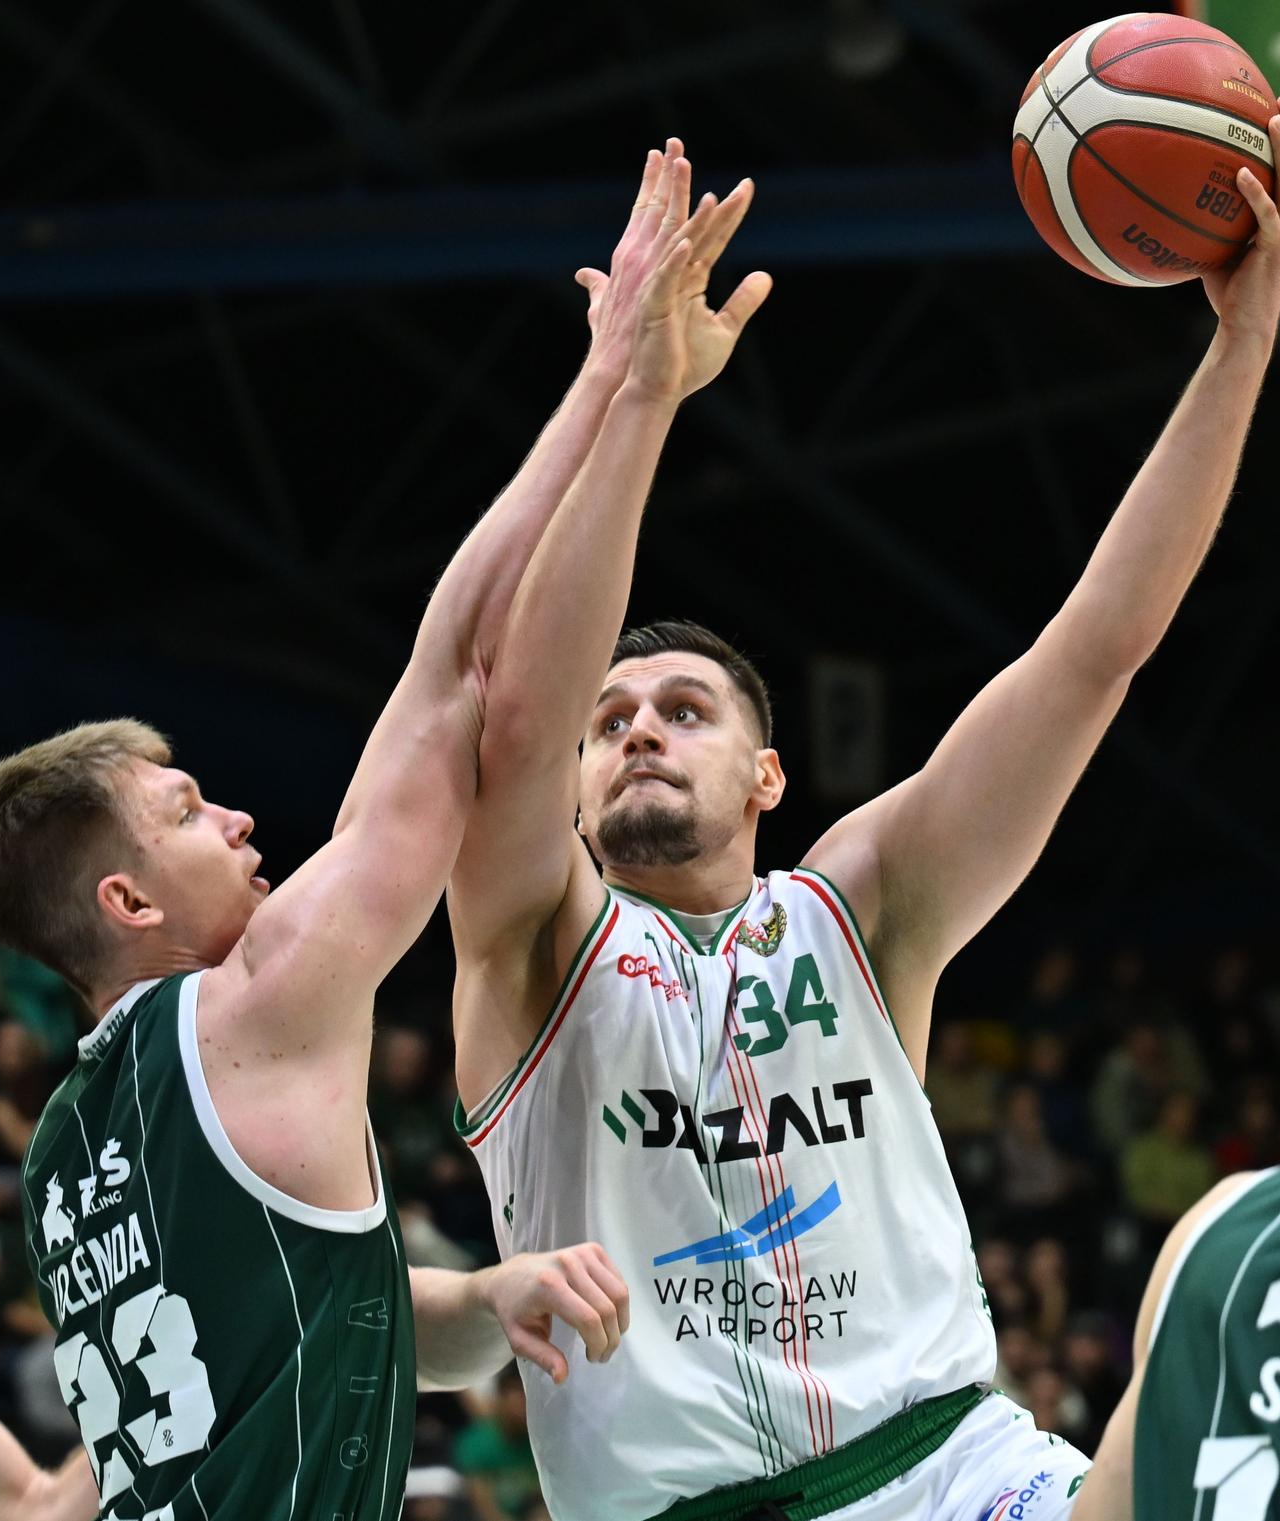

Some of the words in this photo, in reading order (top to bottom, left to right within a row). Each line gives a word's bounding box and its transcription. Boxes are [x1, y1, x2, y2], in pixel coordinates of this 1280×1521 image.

[1227, 123, 1265, 151] BG4550
[1195, 183, 1244, 222] FIBA
[732, 952, 839, 1058] 34
[638, 1077, 874, 1165] BAZALT
[675, 1310, 848, 1345] AIRPORT
[53, 1282, 217, 1510] 23
